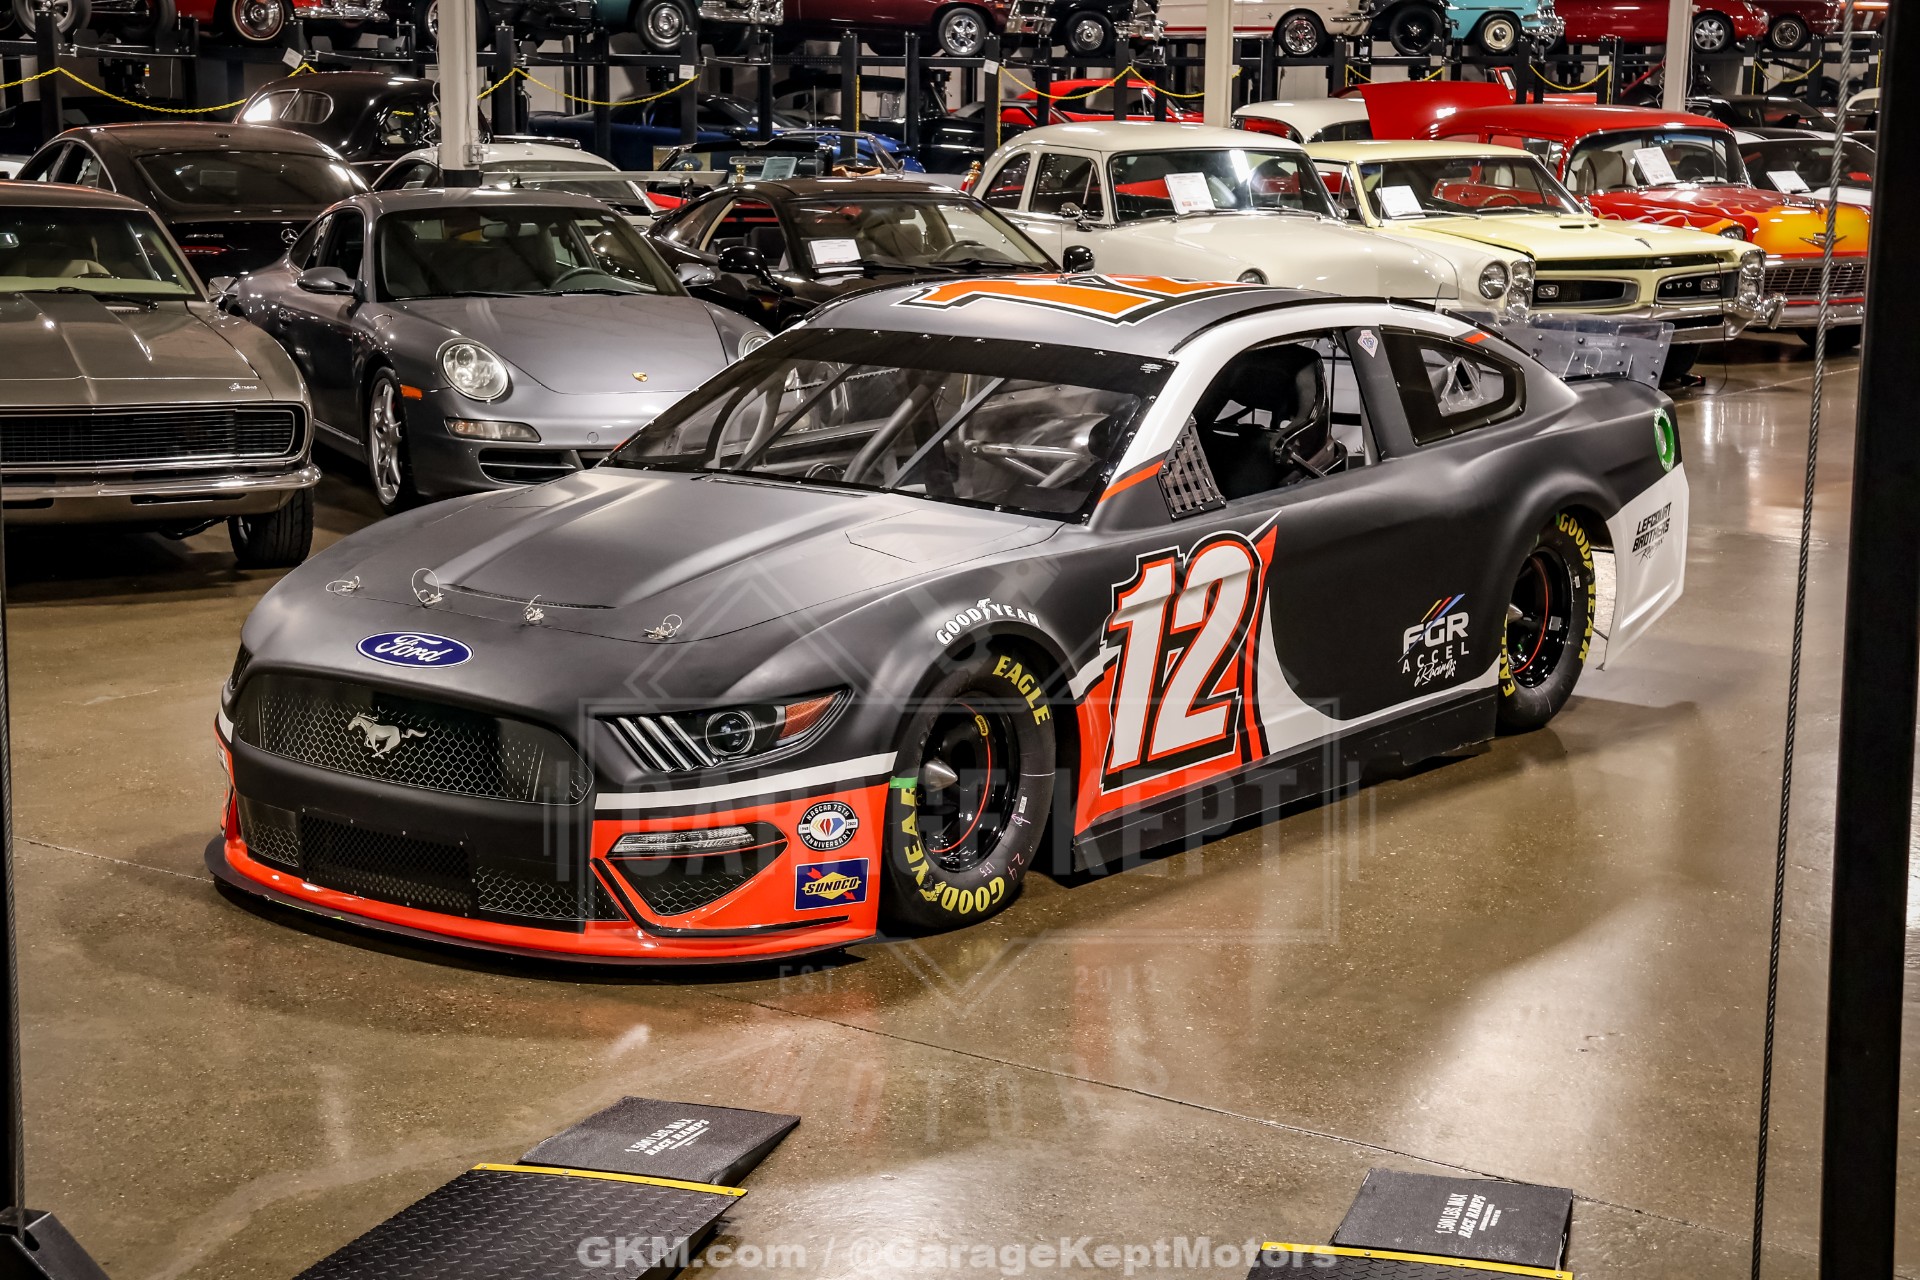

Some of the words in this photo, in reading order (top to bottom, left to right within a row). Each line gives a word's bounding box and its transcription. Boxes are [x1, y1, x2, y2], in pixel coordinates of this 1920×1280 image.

[1665, 281, 1693, 290] GTO
[1632, 517, 1671, 553] BROTHERS
[935, 598, 1041, 647] GOODYEAR
[1402, 611, 1470, 655] FGR
[375, 634, 454, 662] Ford
[1102, 537, 1258, 784] 12
[1402, 641, 1470, 674] ACCEL
[992, 655, 1051, 726] EAGLE
[806, 803, 832, 821] NASCAR
[833, 803, 850, 817] 75TH
[804, 829, 852, 849] ANNIVERSARY
[806, 878, 859, 894] SUNOCO
[644, 1138, 676, 1156] RACE
[671, 1119, 710, 1140] RAMPS
[1465, 1194, 1487, 1220] RAMPS
[1457, 1217, 1477, 1239] RACE
